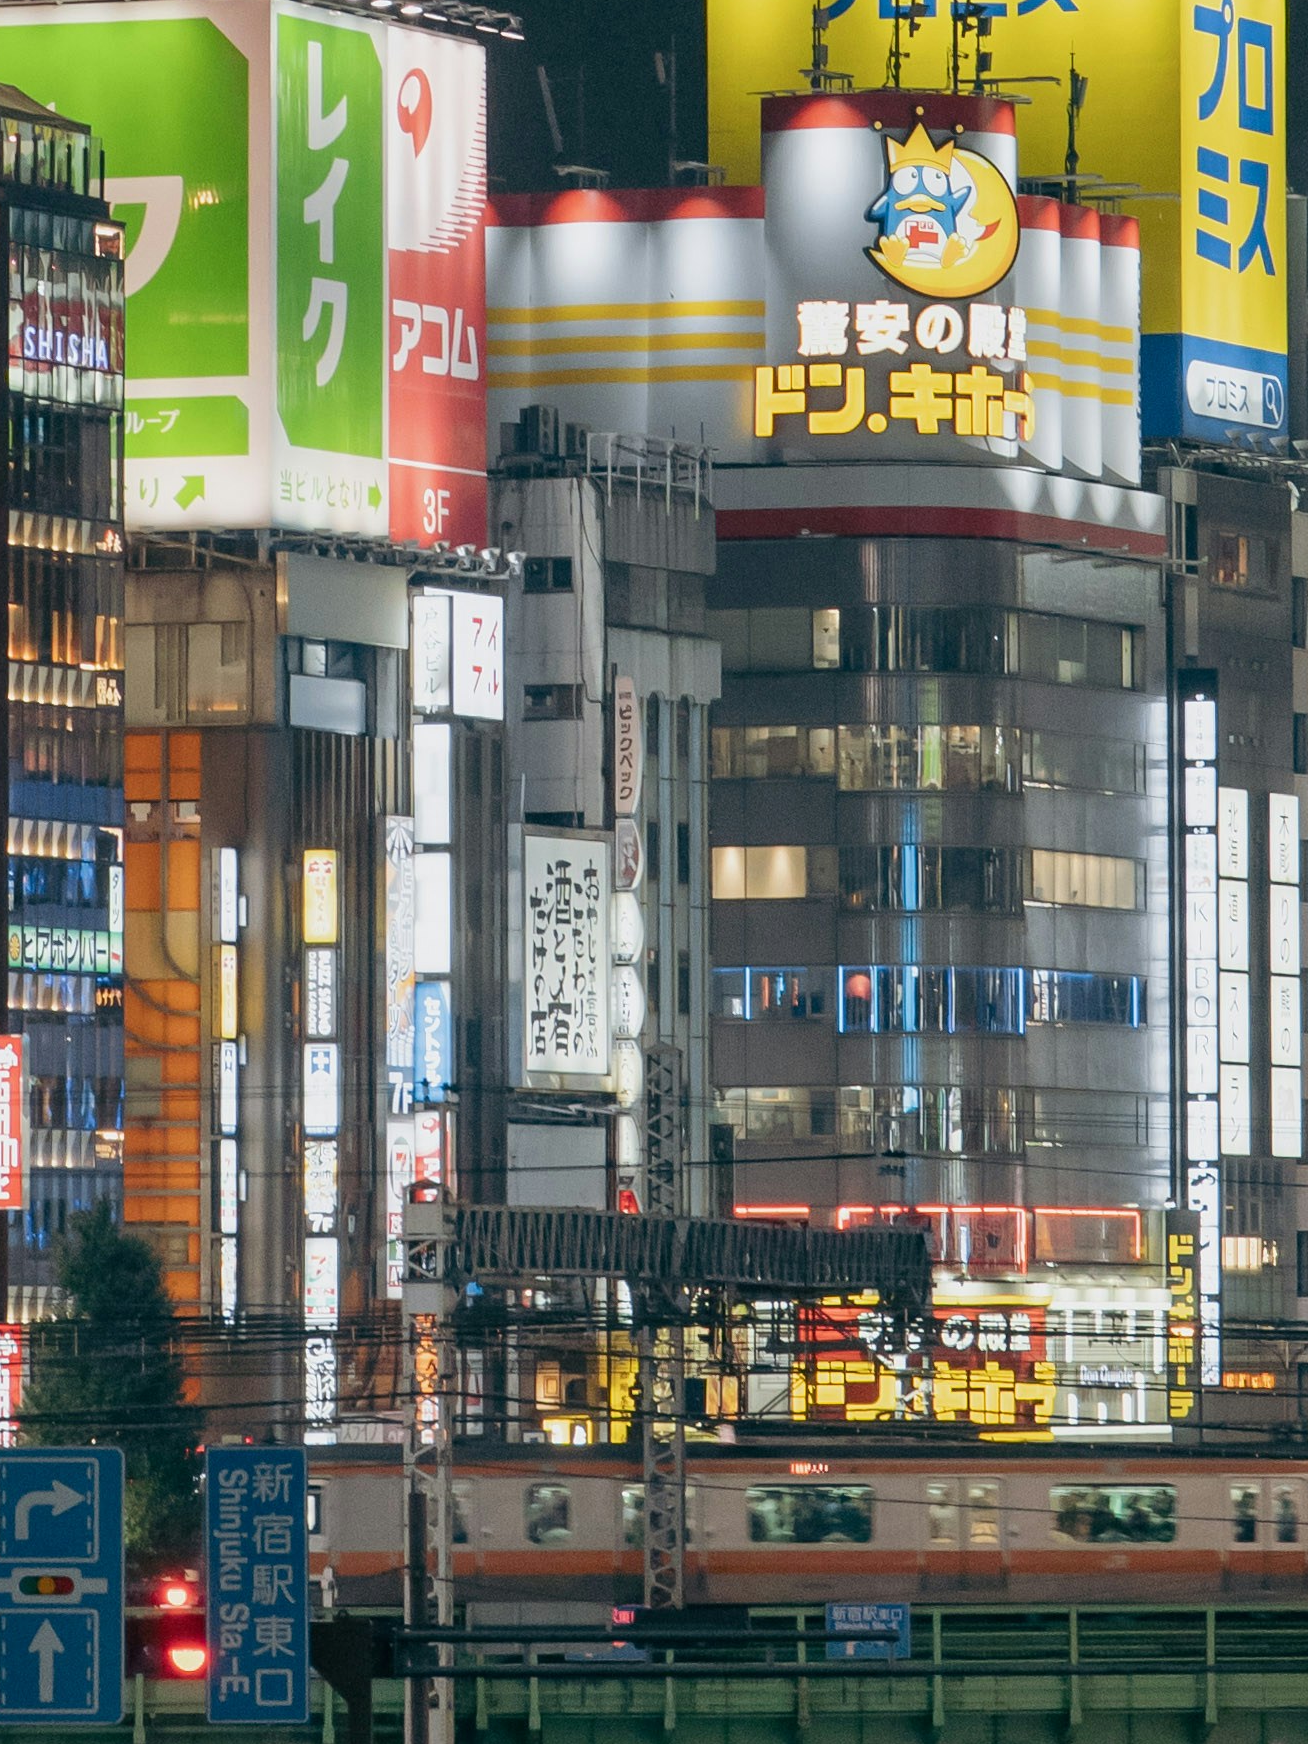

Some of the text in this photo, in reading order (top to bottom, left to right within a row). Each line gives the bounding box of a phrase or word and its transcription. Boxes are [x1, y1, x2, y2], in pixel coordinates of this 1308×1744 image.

[303, 39, 349, 389] レイク
[22, 324, 111, 371] SHISHA
[392, 297, 481, 382] アコム
[797, 299, 1028, 363] 驚安の殿堂
[1204, 376, 1250, 415] プロミス
[124, 407, 181, 436] ループ
[279, 469, 364, 510] 当ビルとなり
[423, 488, 451, 535] 3F
[389, 1071, 413, 1115] 7F
[214, 1468, 250, 1593] Shinjuku
[251, 1462, 296, 1708] 新宿駅東口
